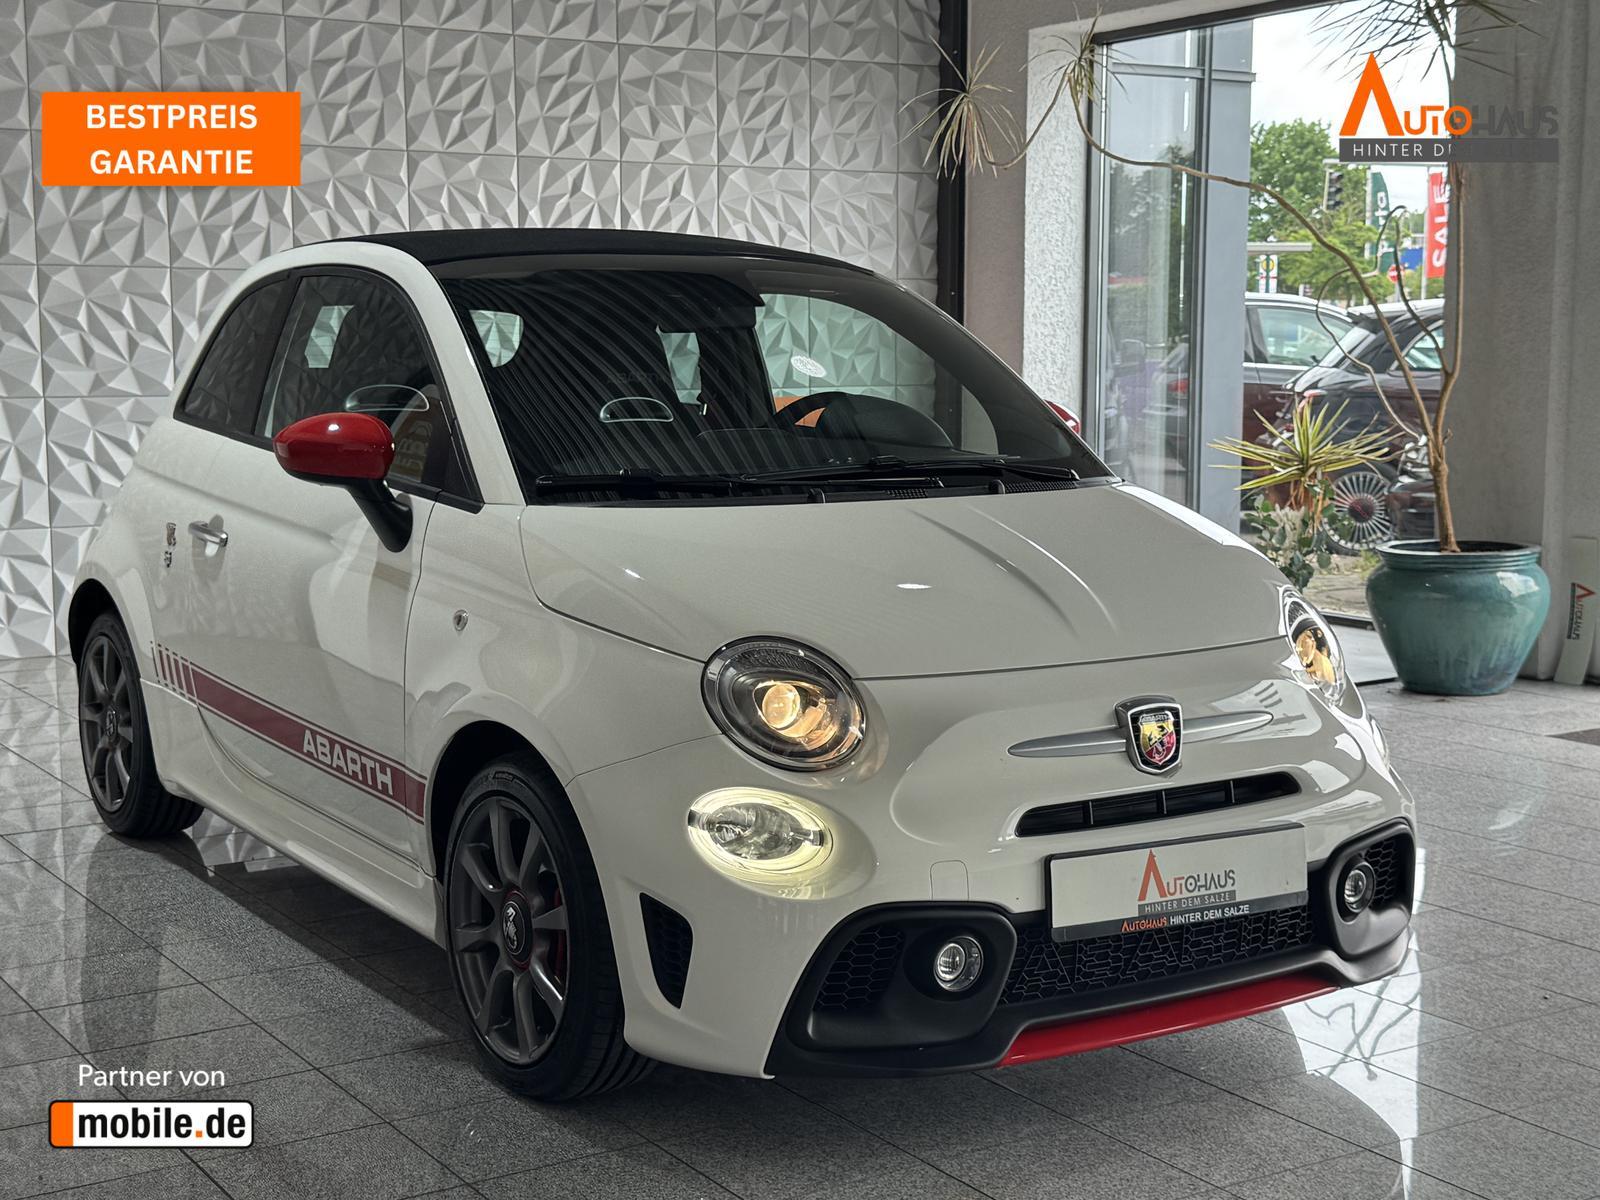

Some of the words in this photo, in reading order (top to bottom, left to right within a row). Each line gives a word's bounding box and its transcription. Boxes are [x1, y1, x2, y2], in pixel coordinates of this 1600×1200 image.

[1432, 184, 1449, 268] SALE
[303, 729, 393, 796] ABARTH
[1138, 849, 1235, 901] AUTOHAUS
[1121, 916, 1168, 932] AUTOHAUS
[1170, 911, 1203, 925] HINTER
[1204, 909, 1222, 919] DEM
[1224, 904, 1250, 917] SALZE
[1145, 901, 1178, 912] HINTER
[1182, 897, 1201, 907] DEM
[1205, 892, 1231, 904] SALZE
